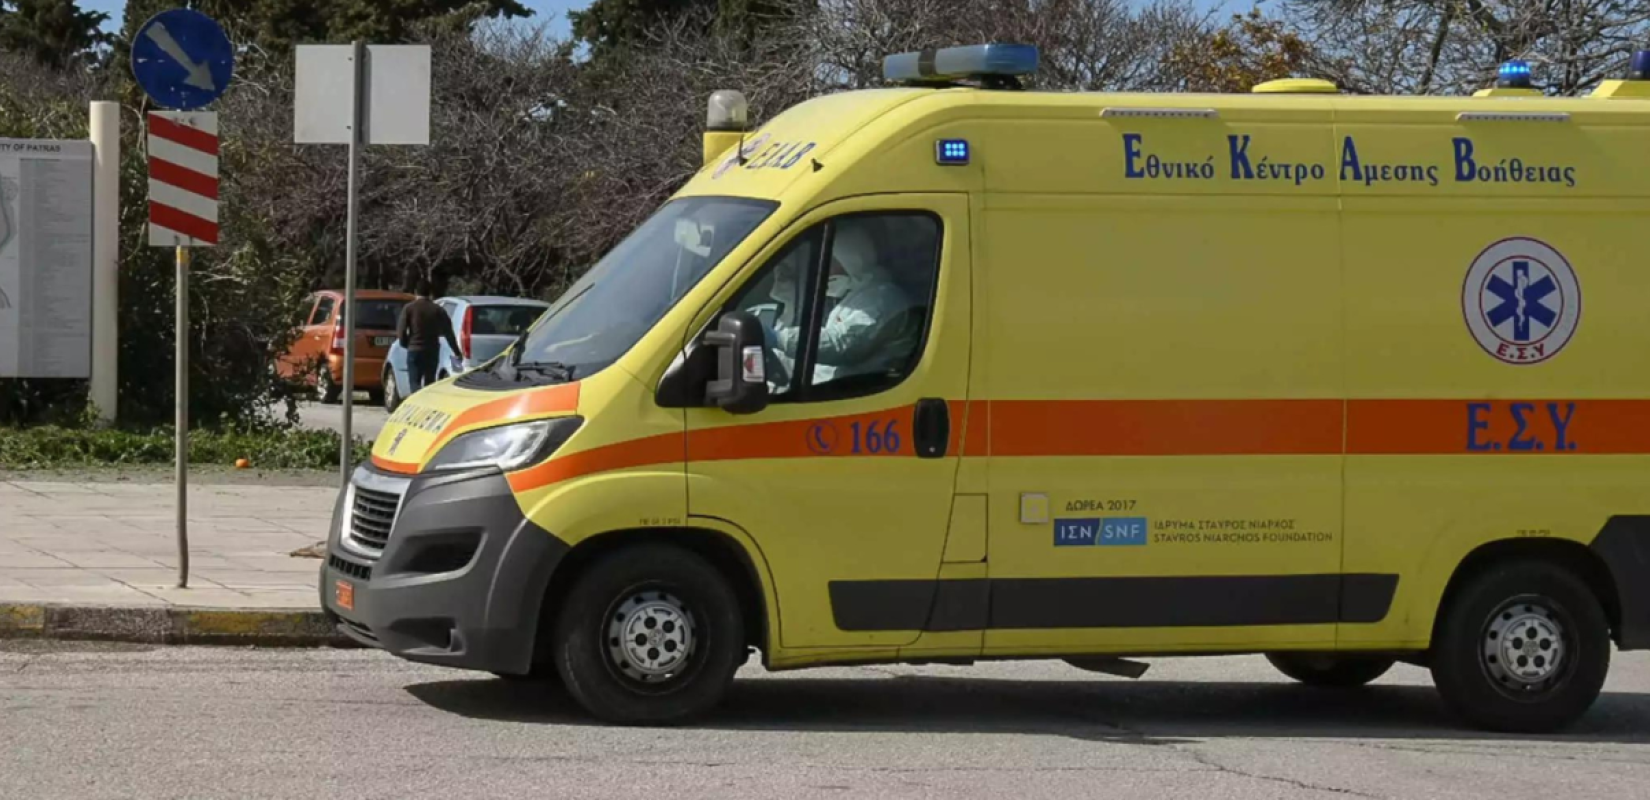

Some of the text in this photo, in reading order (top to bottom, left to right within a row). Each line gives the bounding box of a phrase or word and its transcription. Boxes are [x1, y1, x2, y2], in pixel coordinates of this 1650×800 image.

[13, 143, 25, 152] OF
[27, 144, 61, 153] PATRAS
[1122, 133, 1577, 187] Εθνικό Κέντρο Αμεσης Βοήθειας
[1466, 402, 1578, 451] Ε.Σ.Υ.
[851, 419, 901, 454] 166
[1065, 500, 1137, 511] ΔΩΡΕΑ 2017
[1153, 519, 1296, 530] ΙΔΡΥΜΑ ΣΤΑΥΡΟΣ ΝΙΑΡΧΟΣ
[1061, 524, 1141, 539] ΙΣΝ SNF
[1153, 532, 1333, 543] STAVROS NIARCHOS FOUNDATION
